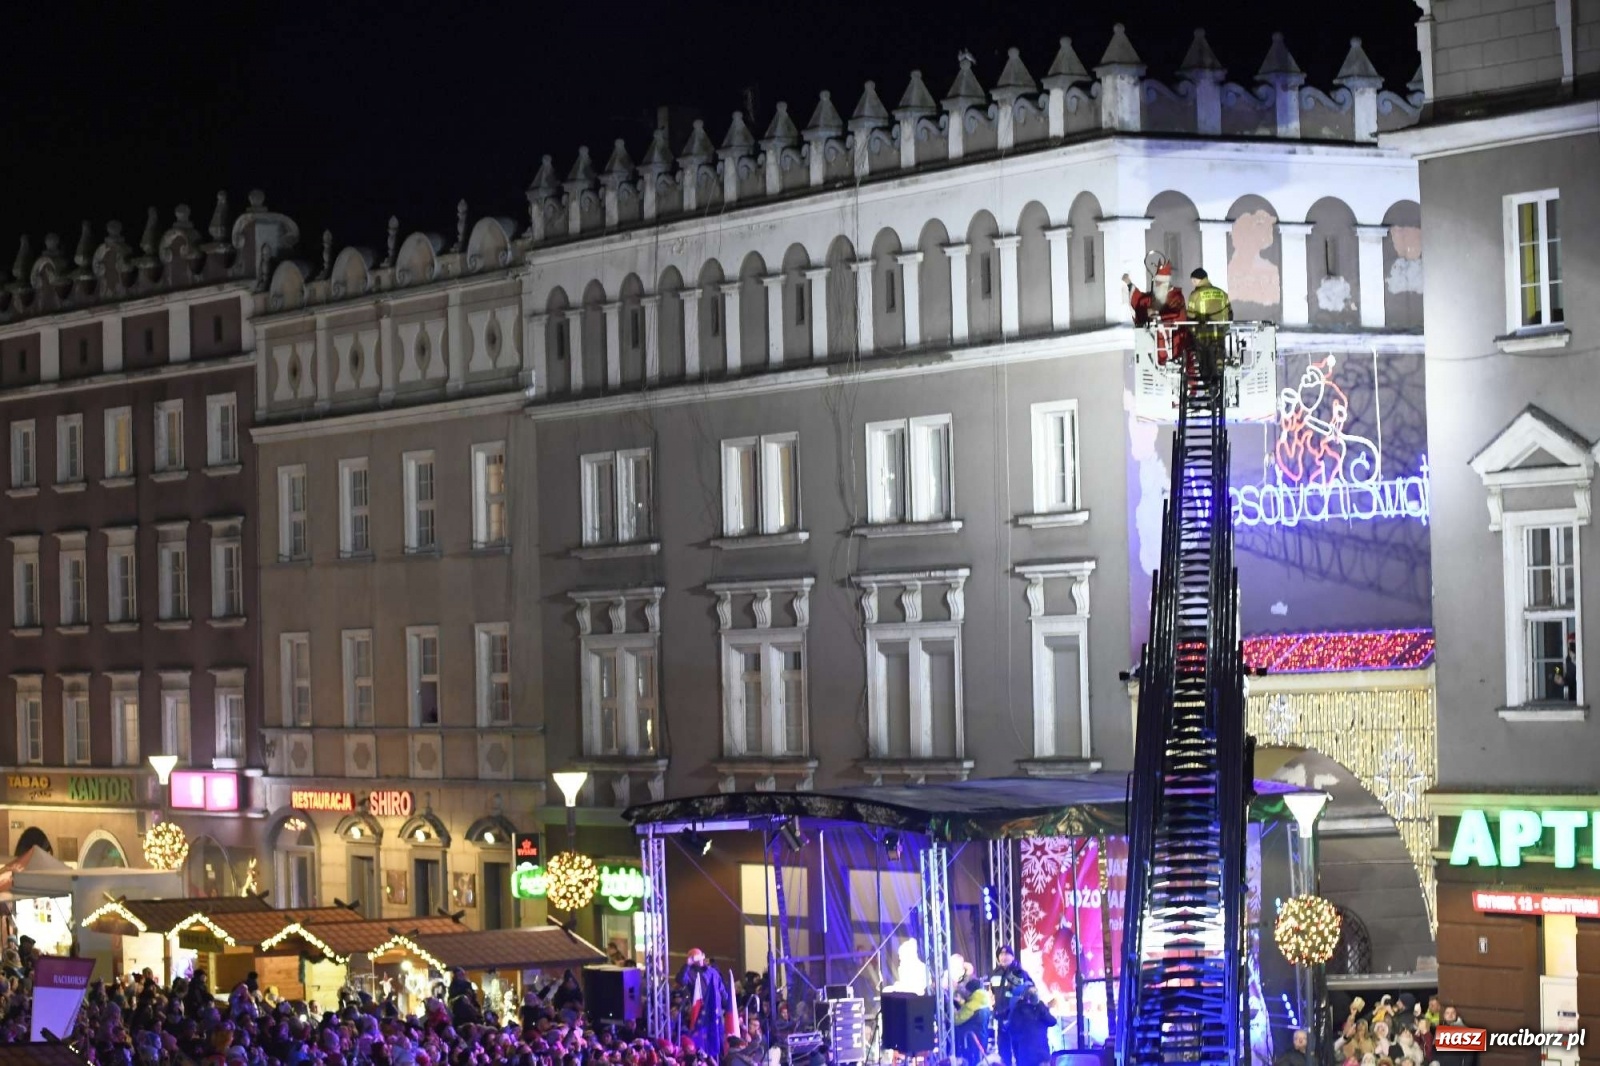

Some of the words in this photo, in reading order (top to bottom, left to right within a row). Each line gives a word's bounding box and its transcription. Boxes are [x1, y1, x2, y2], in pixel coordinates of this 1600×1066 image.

[67, 776, 133, 801] KANTOR
[292, 791, 352, 810] RESTAURACJA
[370, 791, 411, 816] SHIRO
[1450, 809, 1600, 869] APT
